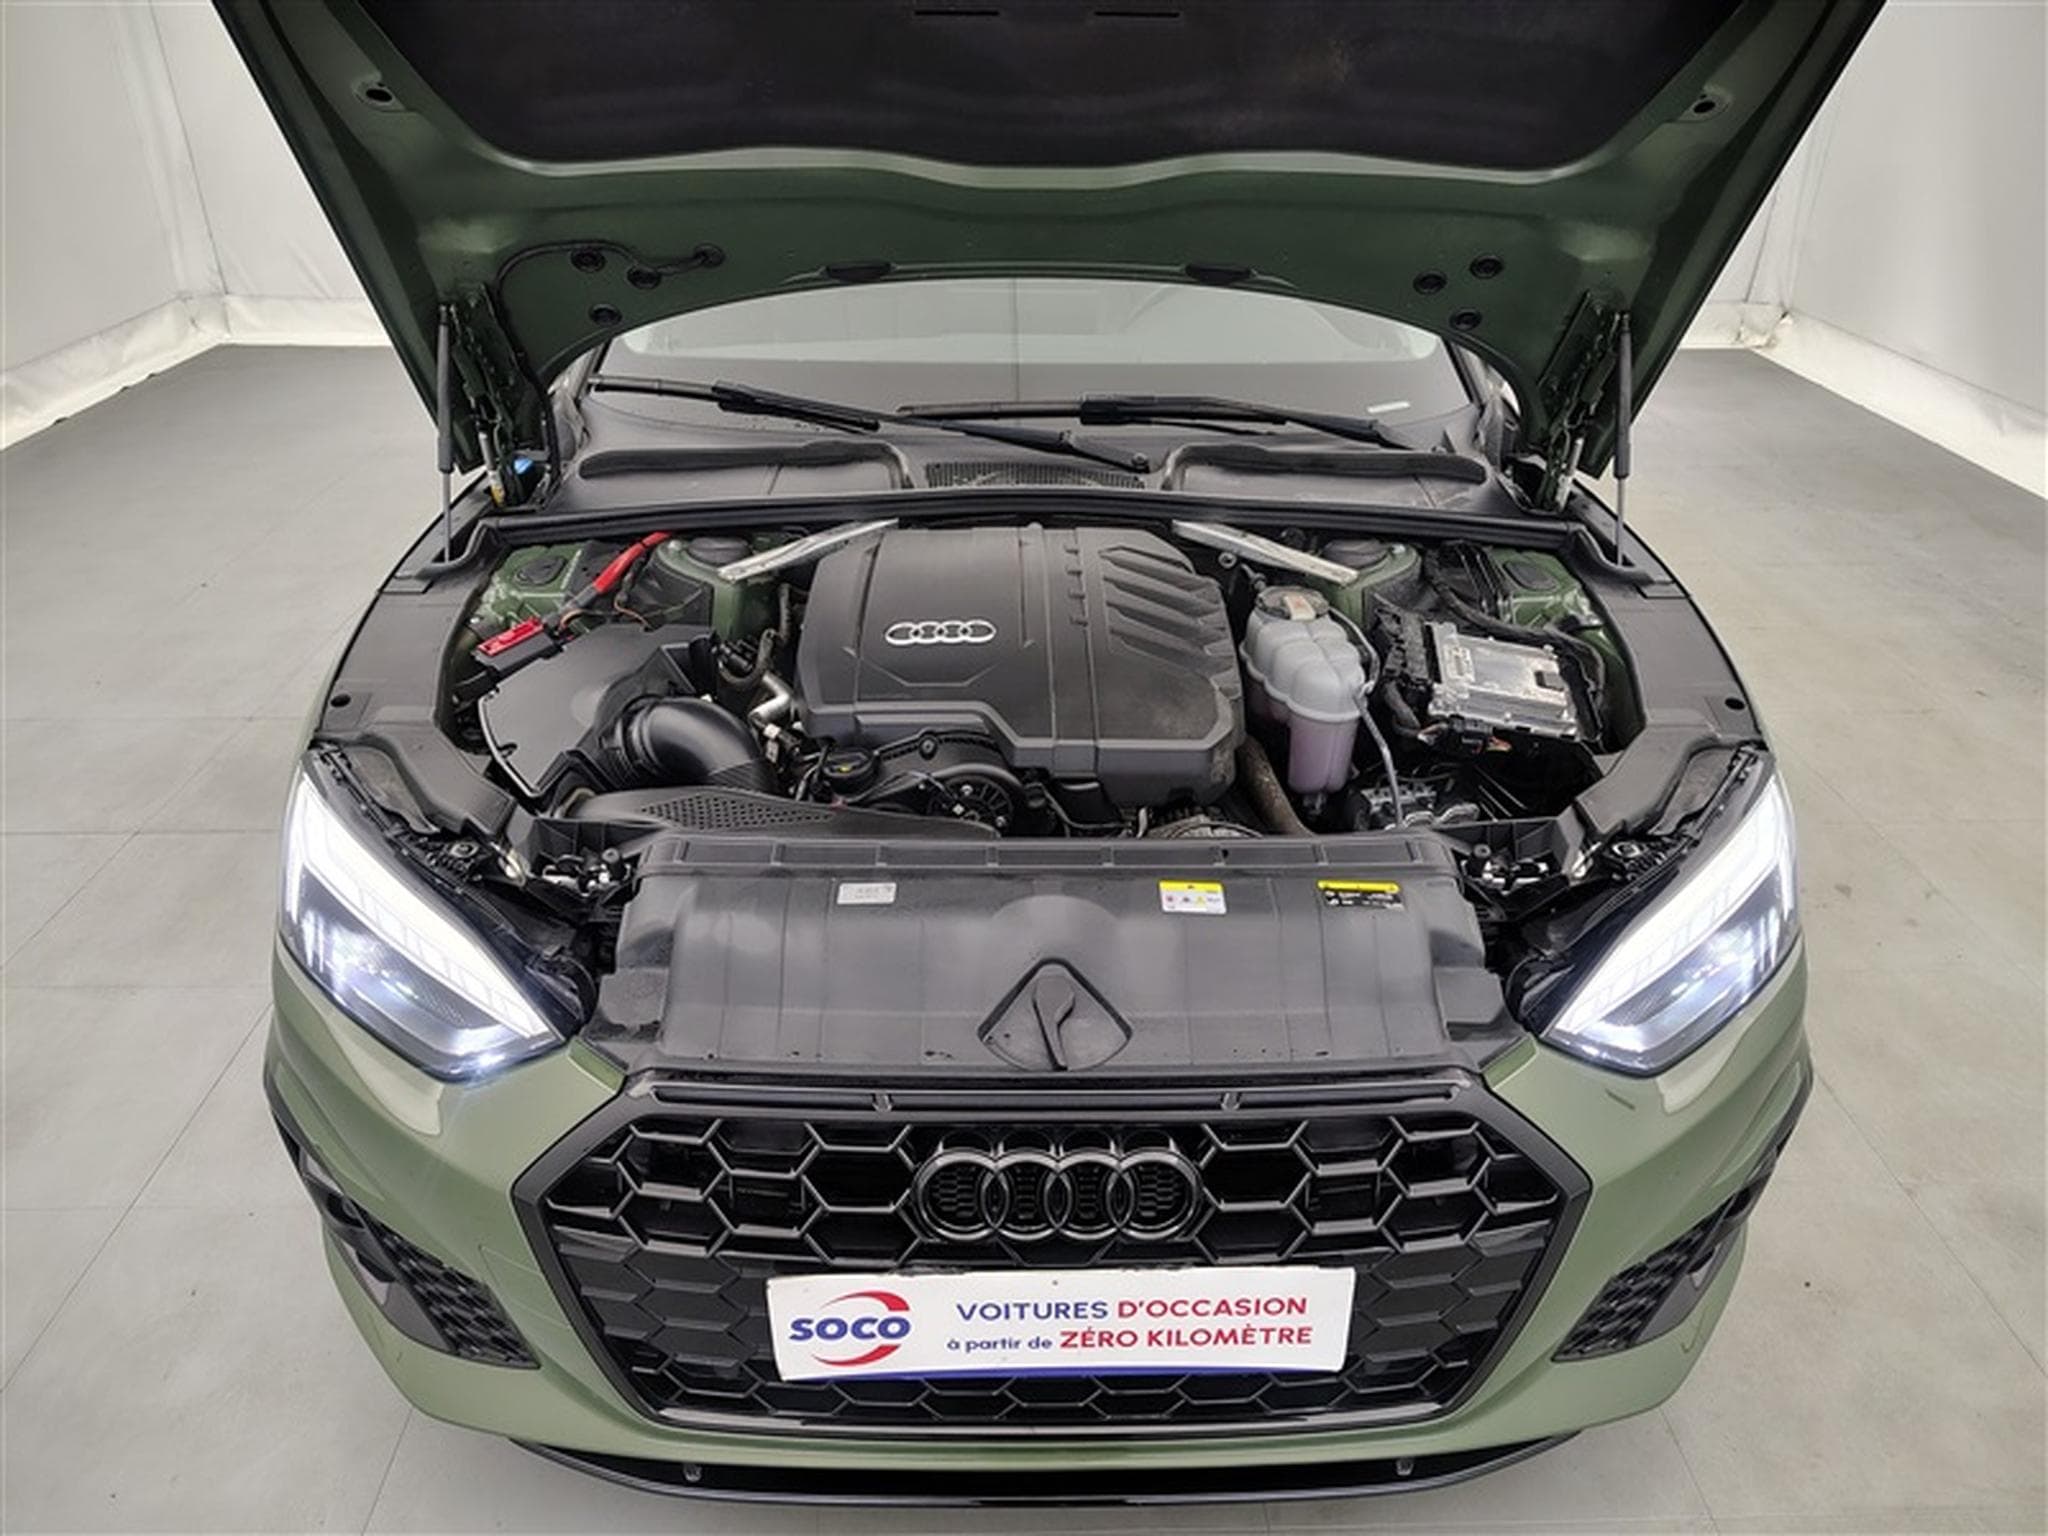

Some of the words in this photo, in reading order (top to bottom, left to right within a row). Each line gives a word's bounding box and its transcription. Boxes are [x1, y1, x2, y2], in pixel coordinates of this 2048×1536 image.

[956, 1301, 1108, 1321] VOITURES
[1117, 1297, 1307, 1319] D'OCCASION
[789, 1316, 911, 1341] SOCO
[946, 1337, 960, 1351] à
[964, 1335, 1021, 1353] partir
[1027, 1334, 1052, 1351] de
[1059, 1326, 1138, 1348] ZÉRO
[1146, 1323, 1313, 1347] KILOMÈTRE
